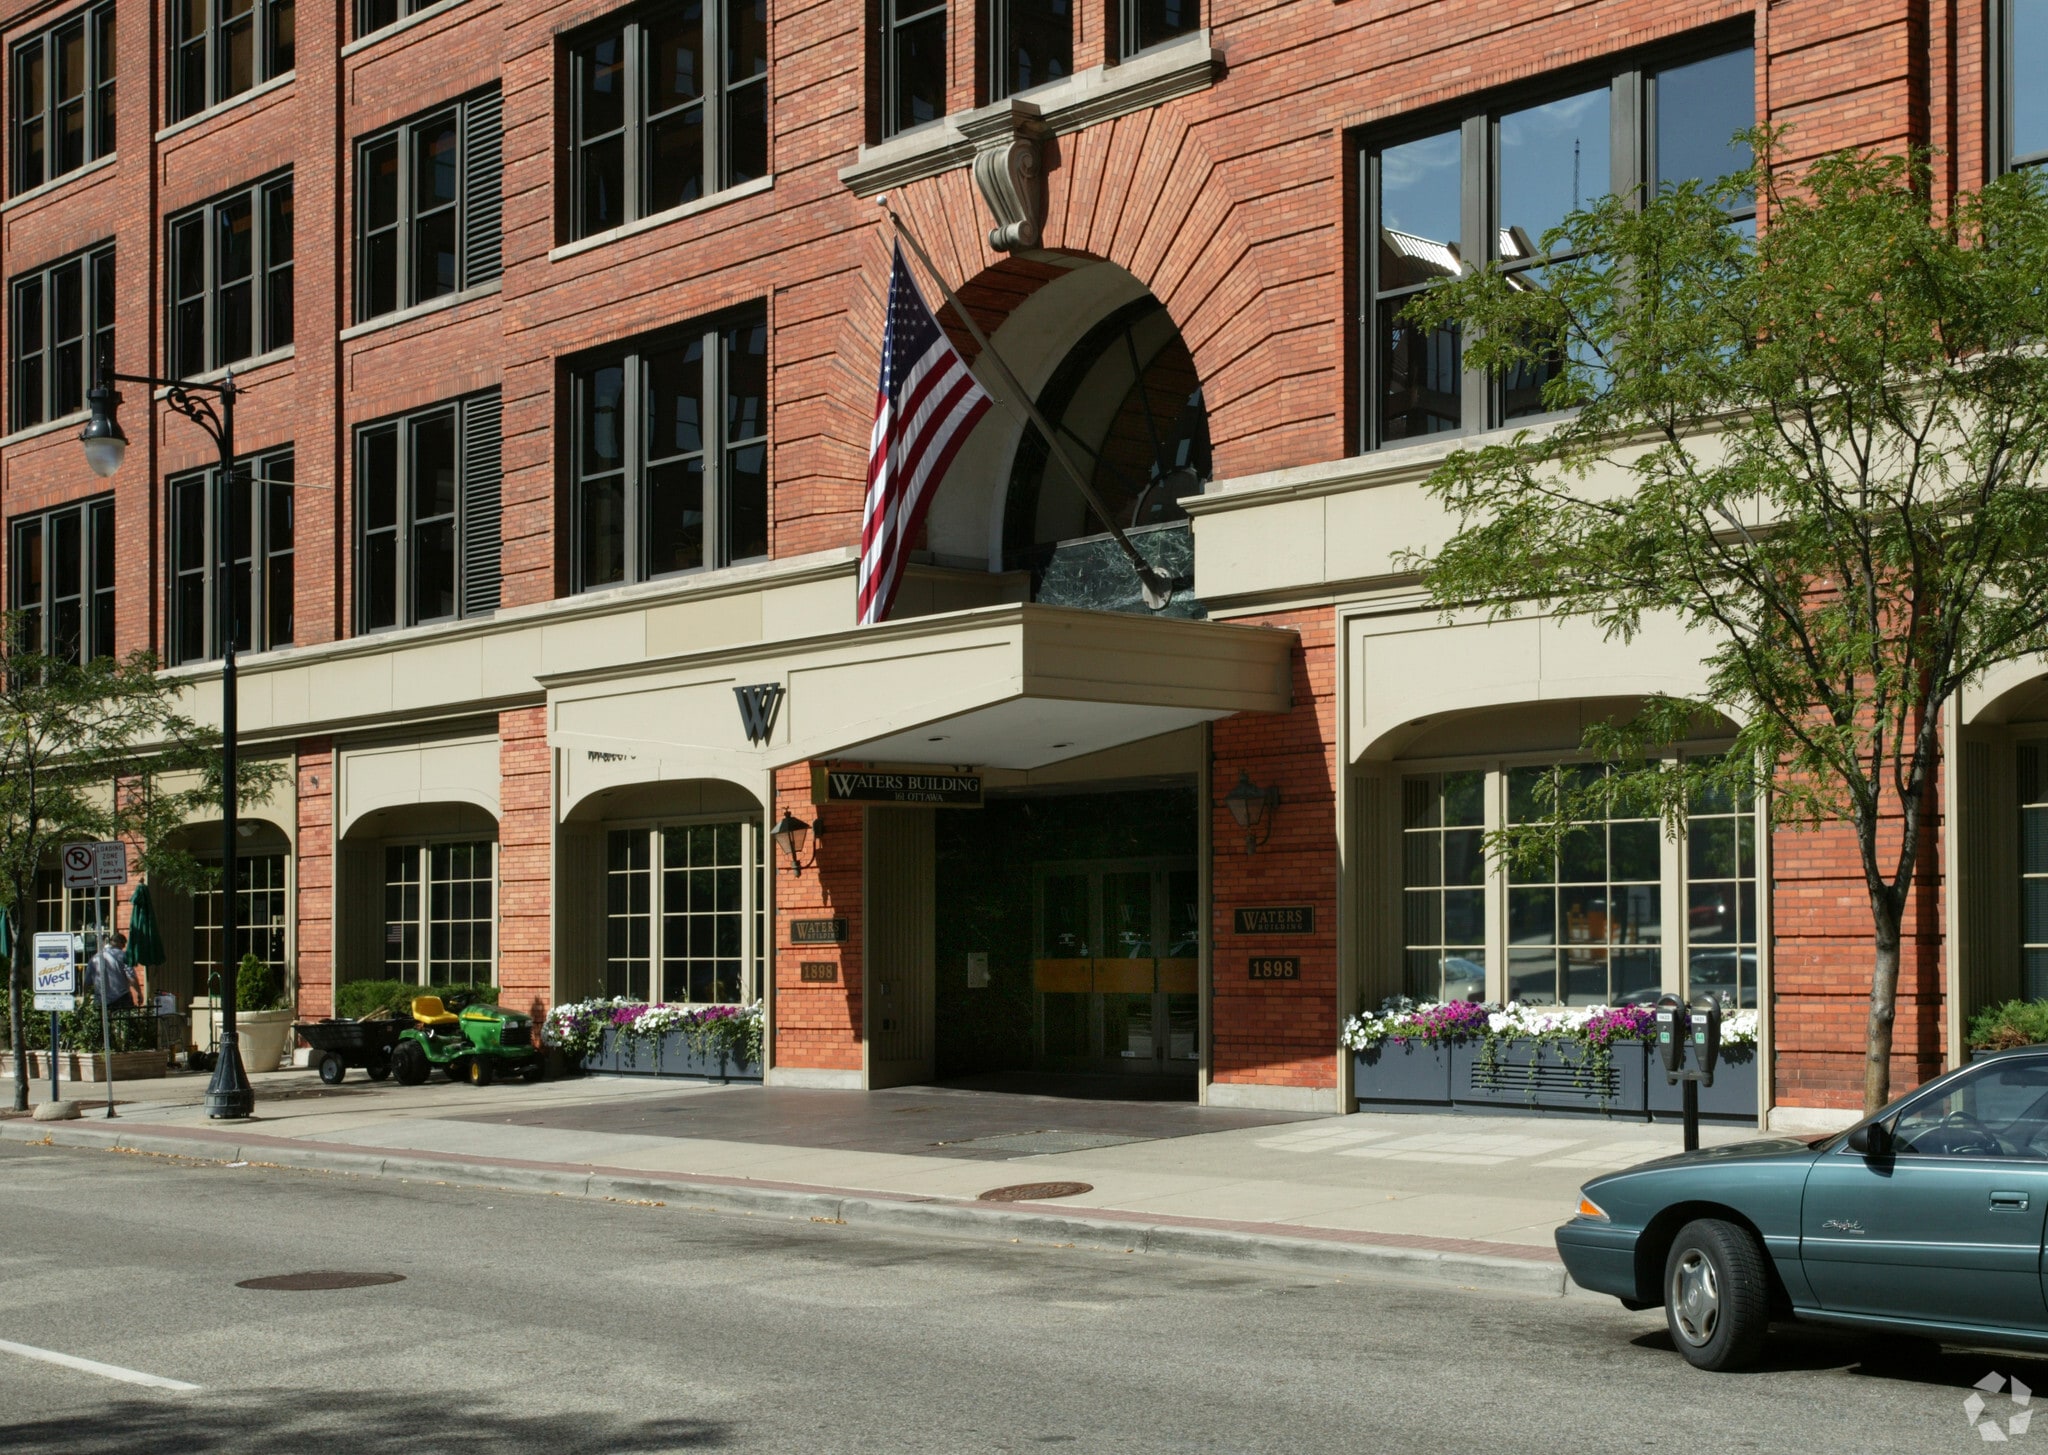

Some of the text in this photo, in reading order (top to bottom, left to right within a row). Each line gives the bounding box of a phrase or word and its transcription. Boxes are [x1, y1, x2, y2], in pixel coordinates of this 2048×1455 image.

[732, 682, 781, 741] W
[830, 773, 979, 798] WATERS BUILDING
[895, 792, 944, 802] 161 OTTAWA
[97, 844, 123, 853] LOADING
[102, 852, 119, 860] ZONE
[1241, 910, 1303, 931] WATERS
[1258, 922, 1304, 931] BUILDING
[796, 921, 840, 940] WATERS
[807, 932, 840, 940] BUILDING
[38, 962, 65, 976] dash
[803, 964, 833, 979] 1898
[1253, 960, 1294, 977] 1898
[38, 970, 70, 988] West
